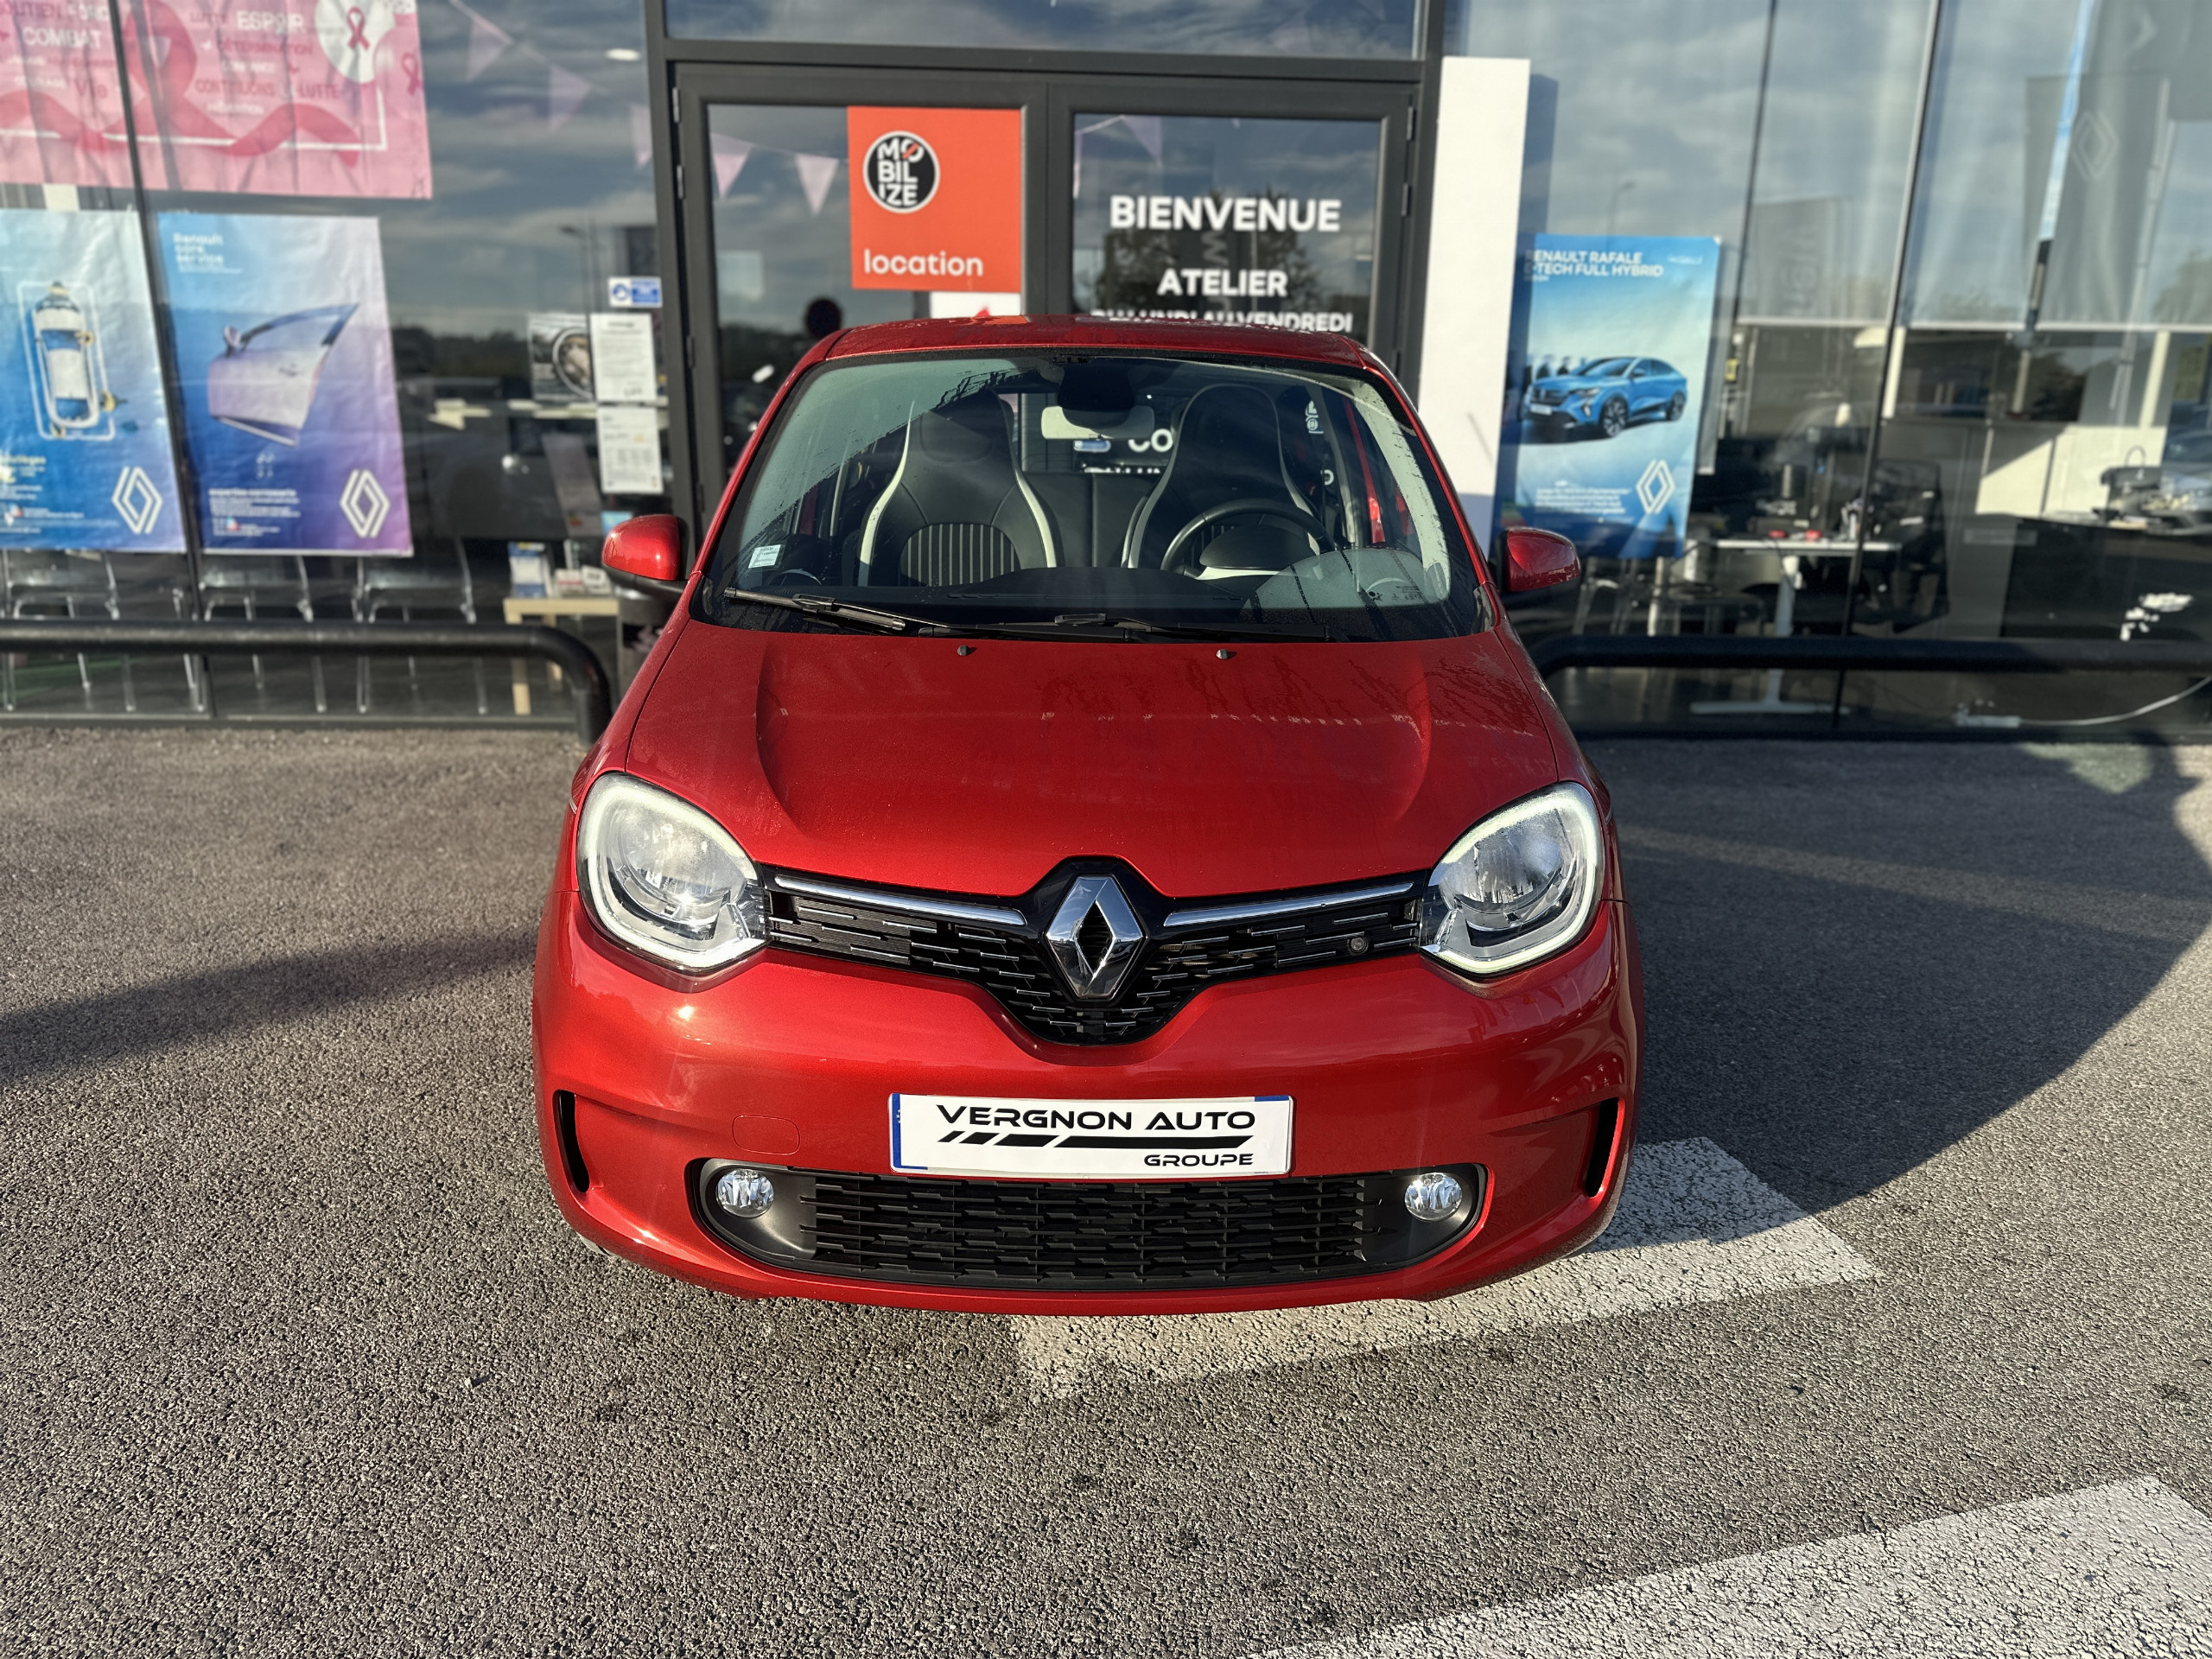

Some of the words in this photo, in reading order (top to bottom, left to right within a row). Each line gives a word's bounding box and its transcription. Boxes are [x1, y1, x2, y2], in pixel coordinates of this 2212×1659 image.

[236, 10, 306, 33] ESPOIR
[22, 26, 102, 48] COMBAT
[1110, 195, 1342, 232] BIENVENUE
[864, 248, 983, 277] location
[1590, 251, 1643, 264] RAFALE
[1575, 263, 1609, 276] FULL
[1611, 264, 1664, 277] HYBRID
[1158, 269, 1288, 297] ATELIER
[936, 1104, 1132, 1130] VERGNON
[1145, 1111, 1255, 1130] AUTO
[1143, 1153, 1254, 1166] GROUPE
